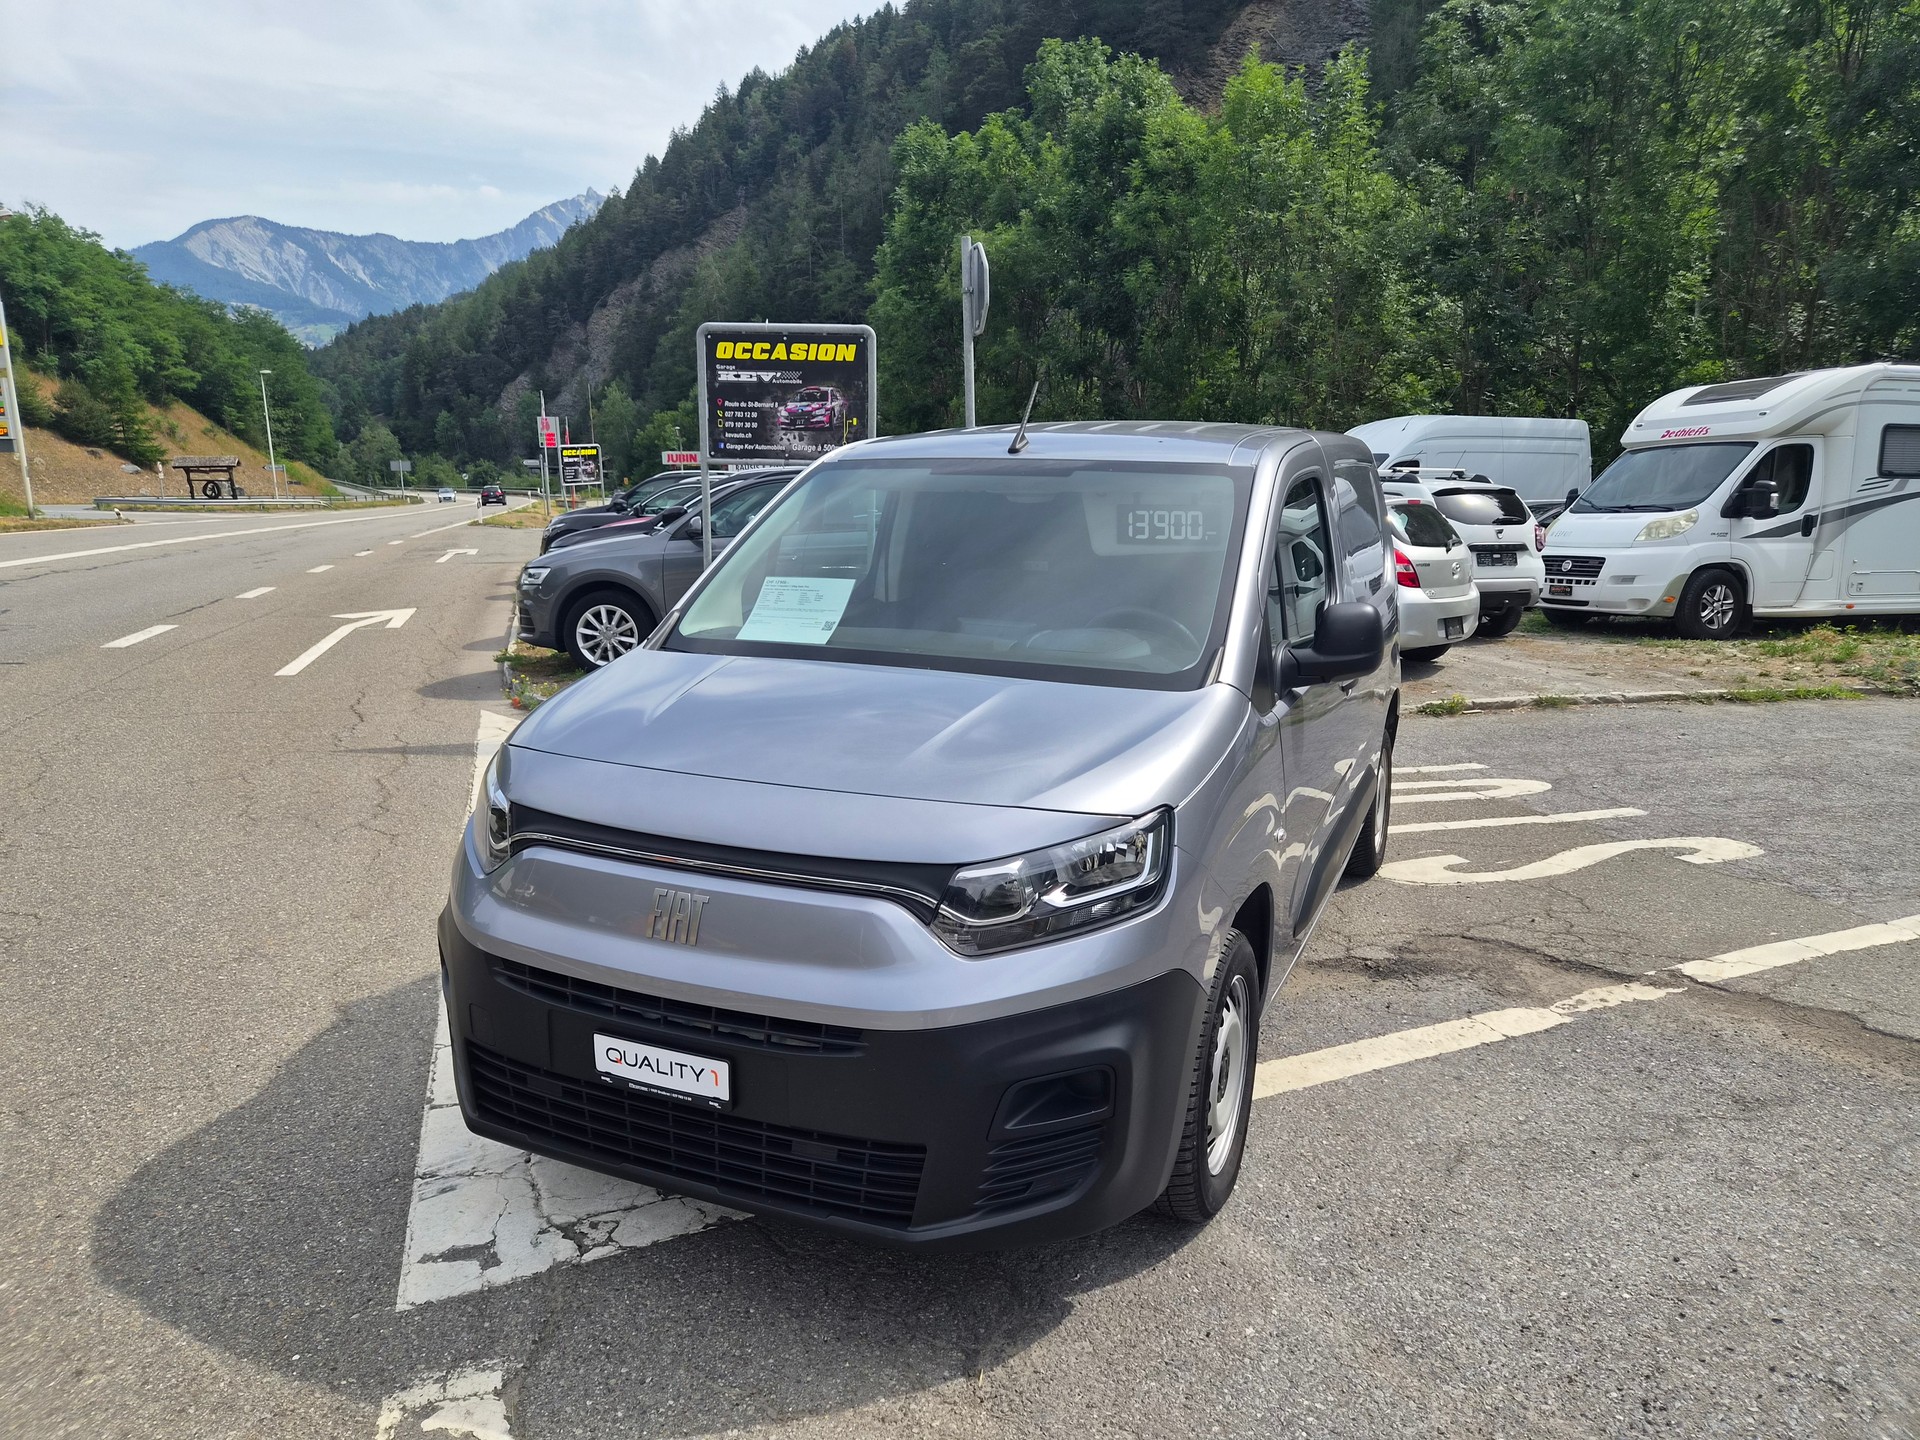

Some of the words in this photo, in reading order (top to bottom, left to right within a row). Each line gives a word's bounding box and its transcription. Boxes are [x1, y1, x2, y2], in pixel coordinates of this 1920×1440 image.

[716, 342, 857, 362] OCCASION
[724, 400, 739, 408] Route
[1660, 426, 1711, 439] Dethleffs
[562, 448, 597, 456] OCCASION
[792, 443, 816, 452] Garage
[666, 453, 698, 463] JUBIN
[646, 887, 710, 947] FIAT
